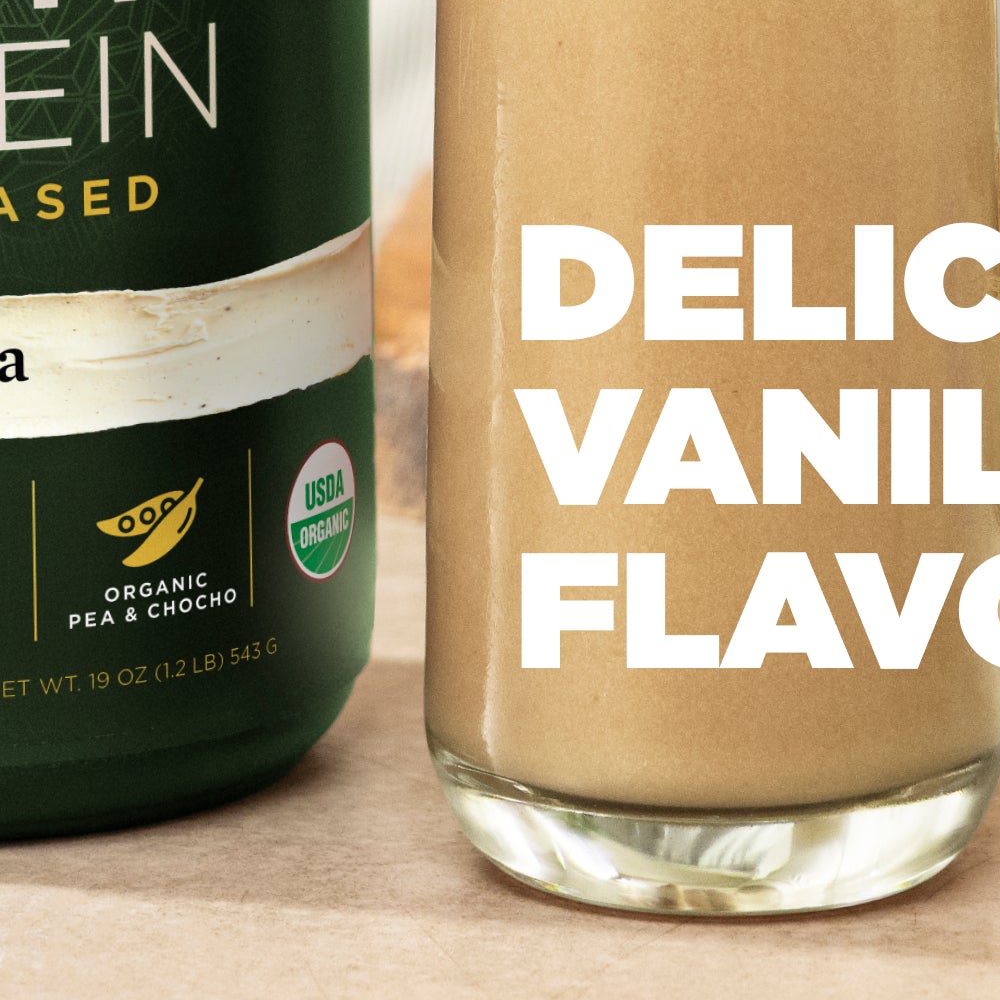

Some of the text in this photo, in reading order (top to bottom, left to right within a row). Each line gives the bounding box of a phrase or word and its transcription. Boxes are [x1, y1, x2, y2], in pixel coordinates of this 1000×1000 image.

[0, 22, 217, 151] EIN
[304, 469, 344, 511] USDA
[300, 507, 350, 550] ORGANIC
[104, 572, 208, 603] ORGANIC
[68, 588, 237, 630] PEA & CHOCHO
[2, 637, 278, 698] ET WT. 19 OZ (1.2 LB) 543 G
